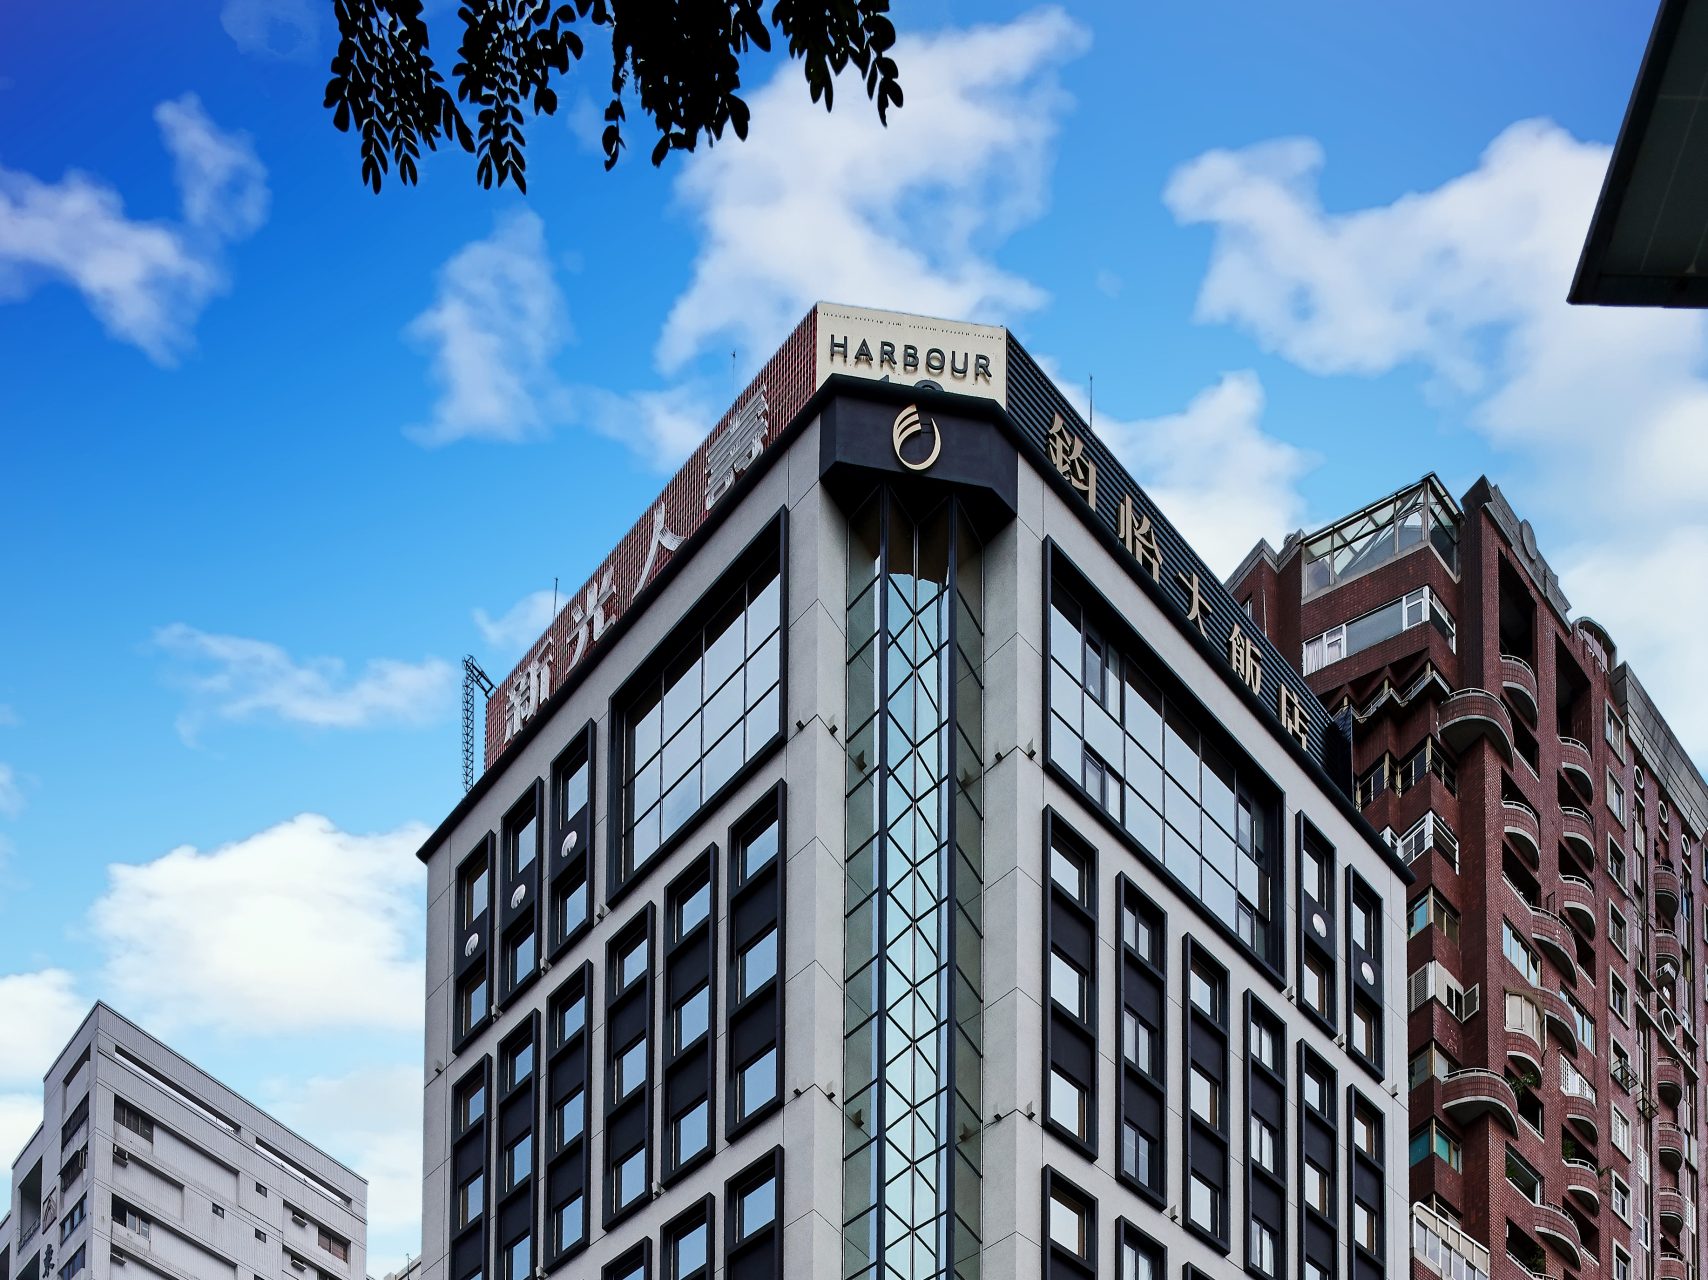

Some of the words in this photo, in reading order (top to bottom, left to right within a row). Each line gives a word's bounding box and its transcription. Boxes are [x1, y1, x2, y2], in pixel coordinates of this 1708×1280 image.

[830, 334, 992, 378] HARBOUR
[504, 383, 768, 745] 新光人壽
[1047, 412, 1309, 752] 鈞怡大飯店
